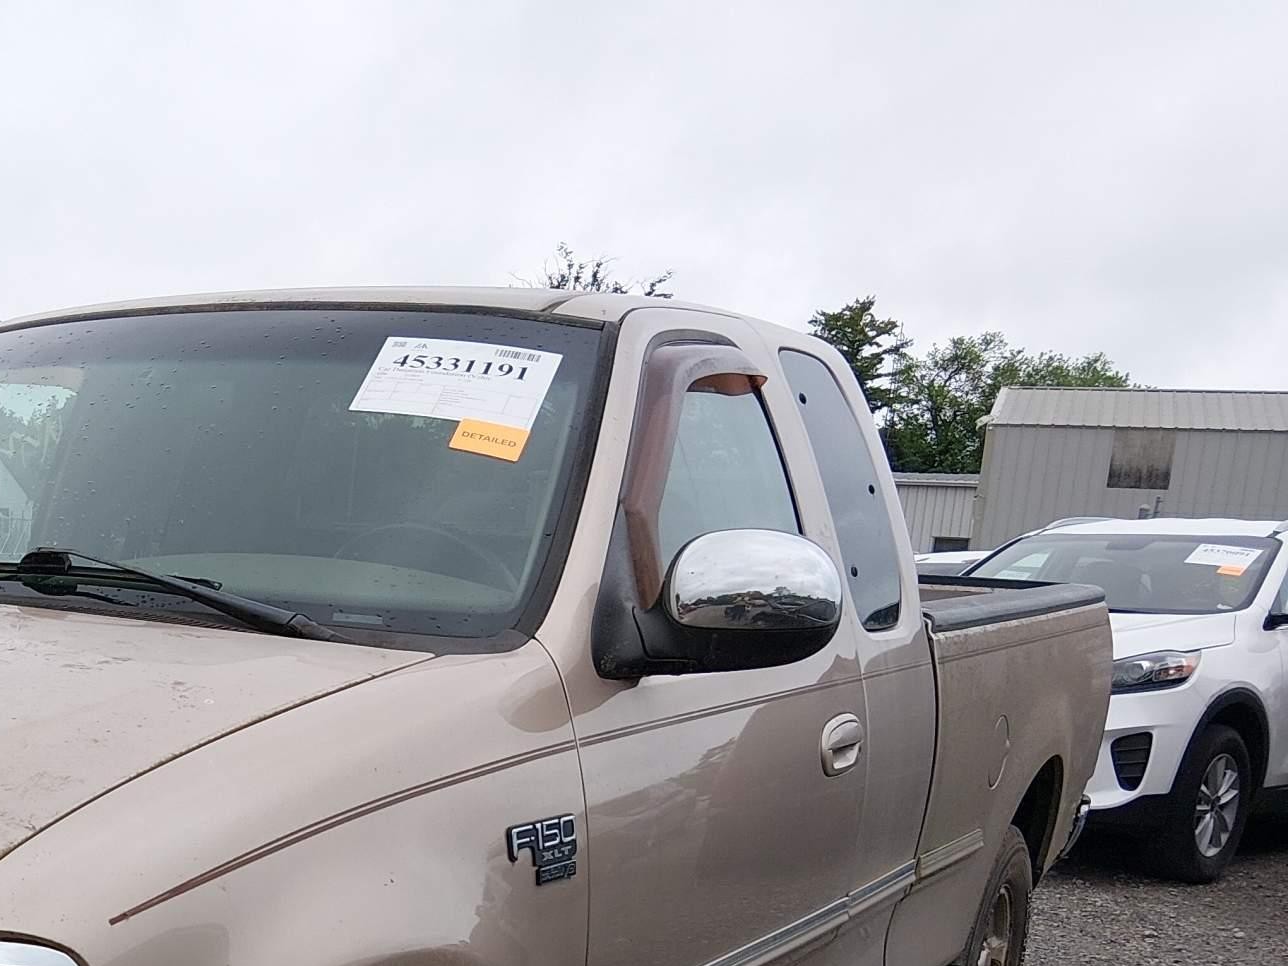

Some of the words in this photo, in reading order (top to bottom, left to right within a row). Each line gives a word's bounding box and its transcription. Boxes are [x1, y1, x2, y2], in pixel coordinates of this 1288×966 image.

[393, 353, 530, 382] 45331191
[461, 431, 517, 448] DETAILED
[542, 846, 573, 861] XLT
